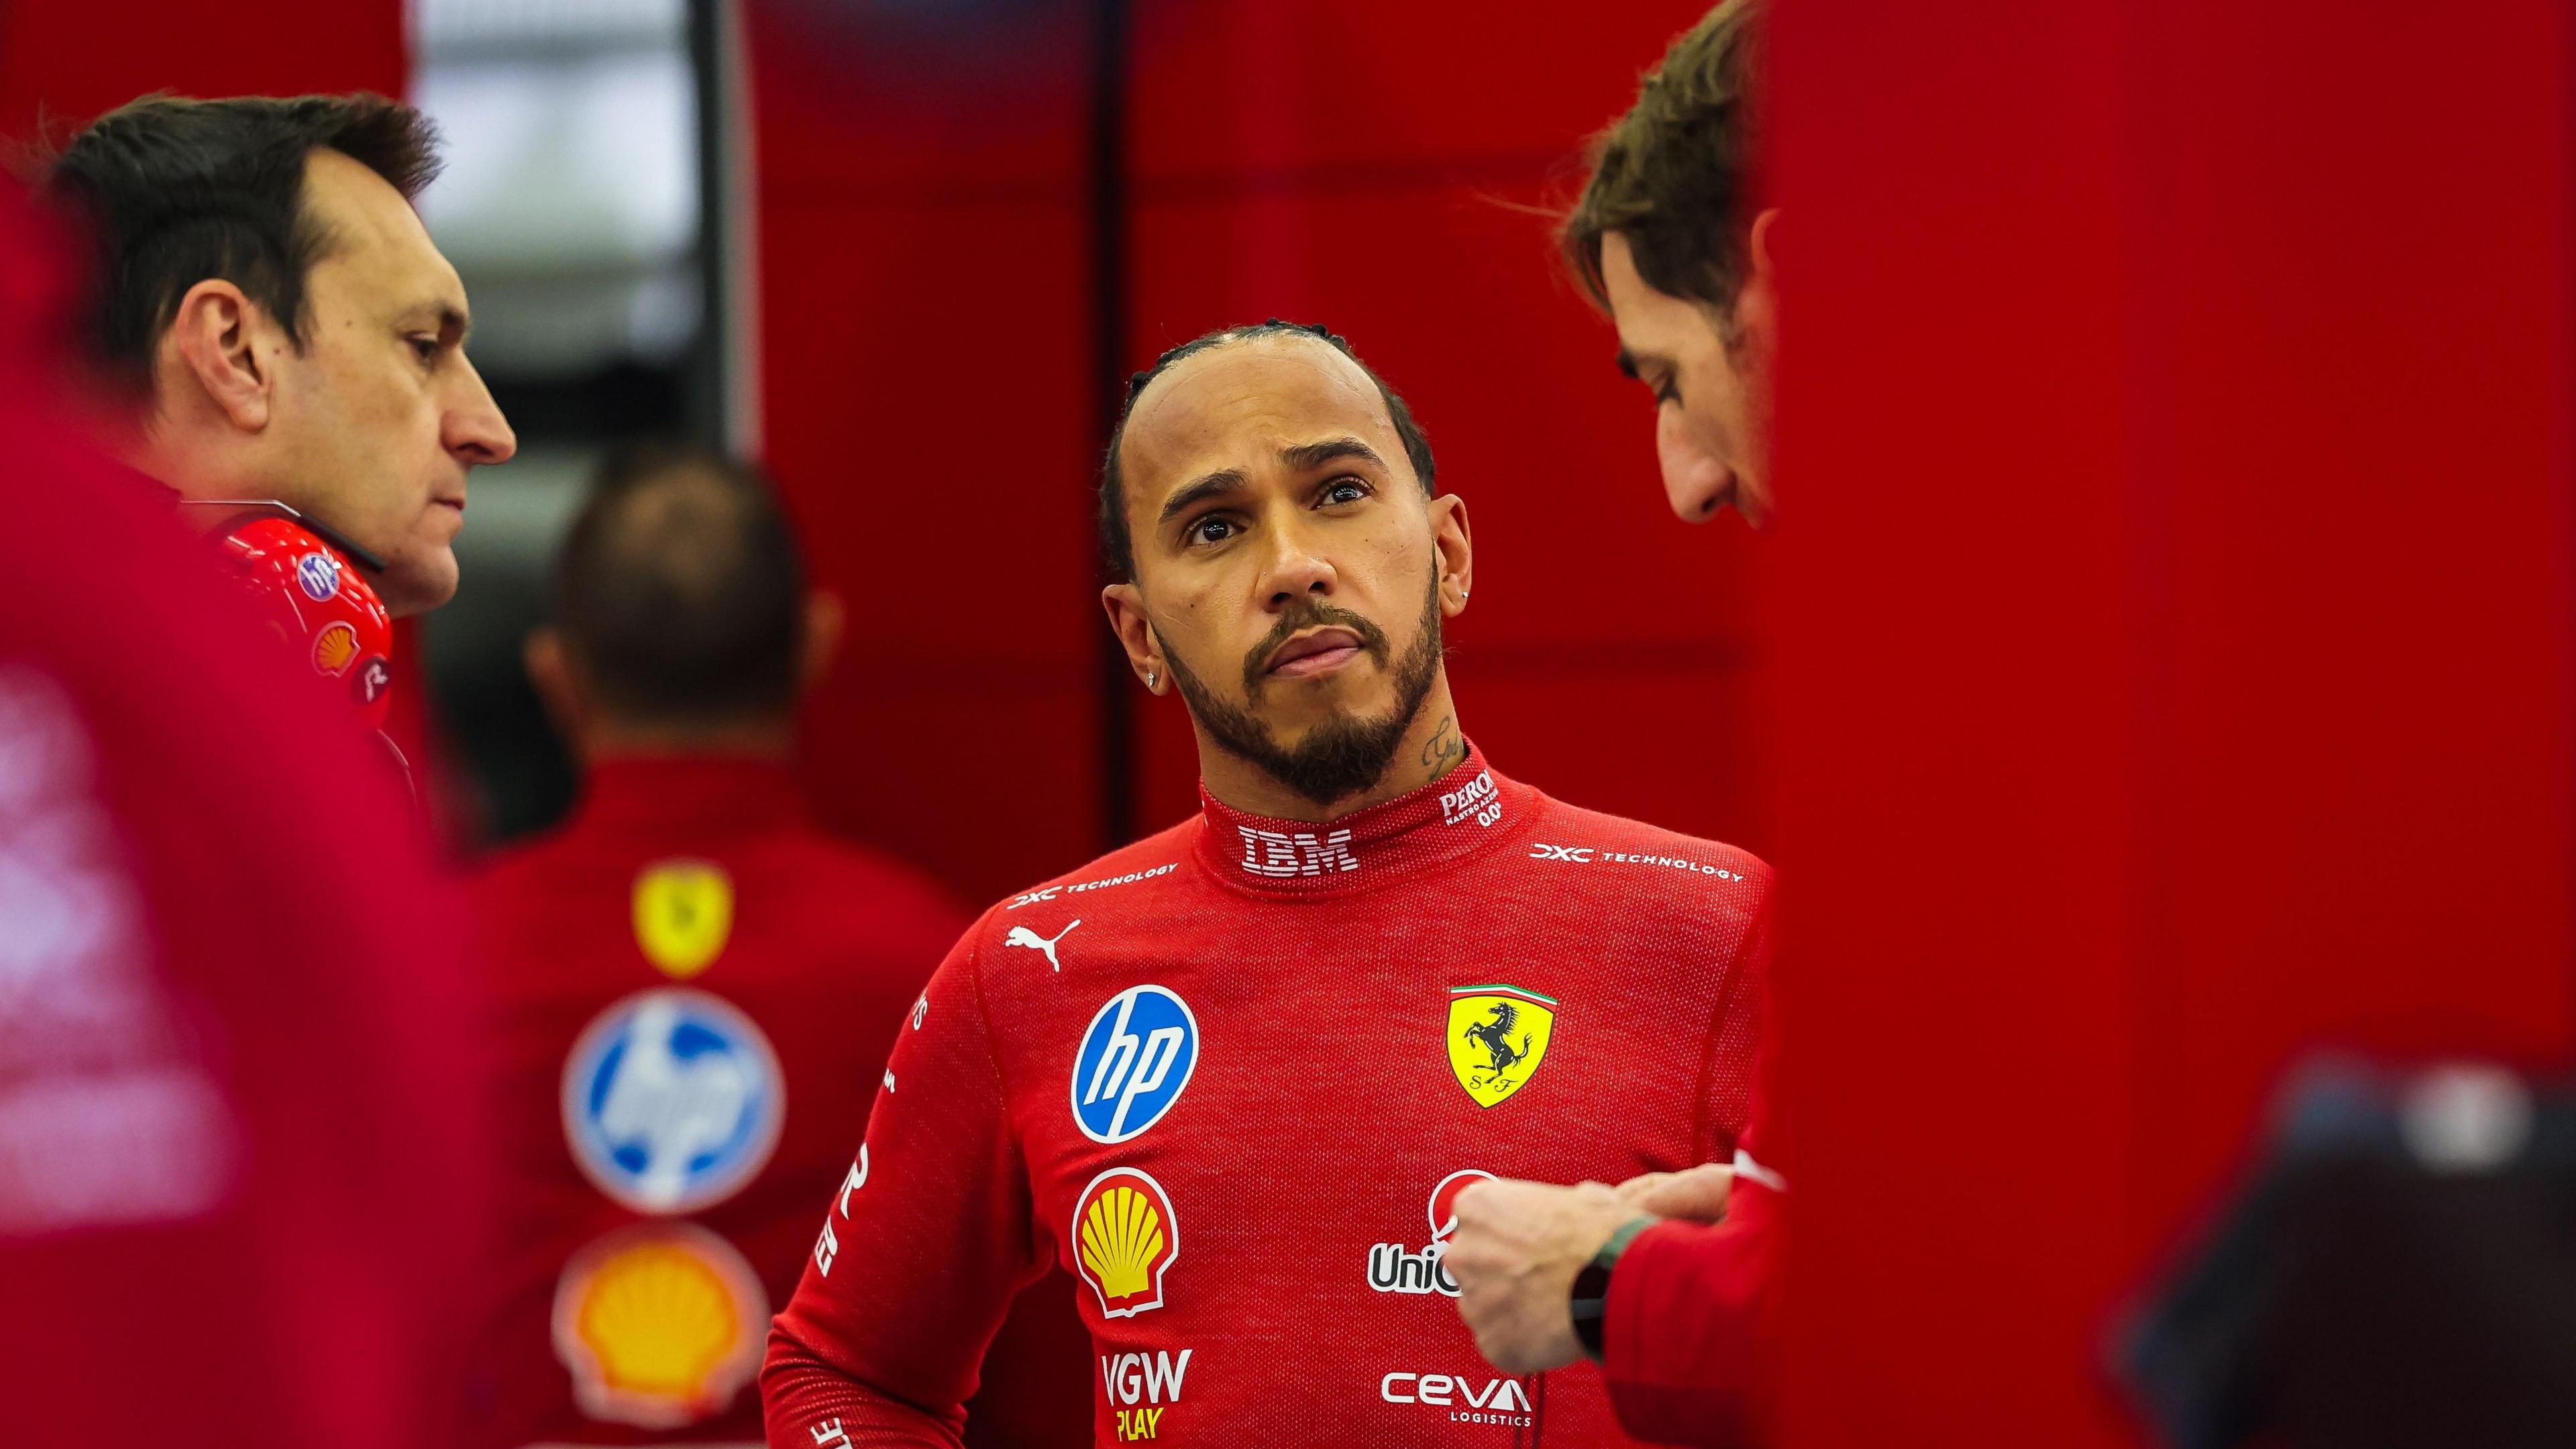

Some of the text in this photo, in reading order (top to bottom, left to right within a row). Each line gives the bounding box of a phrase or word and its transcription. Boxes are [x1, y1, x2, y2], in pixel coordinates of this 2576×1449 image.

[1446, 803, 1480, 826] NASTRO
[1238, 825, 1358, 877] IBM
[1529, 843, 1744, 883] DXC TECHNOLOGY
[1006, 862, 1179, 910] DXC TECHNOLOGY
[1083, 991, 1183, 1138] hp
[1469, 1075, 1482, 1090] S
[1101, 1348, 1193, 1407] VGW
[1116, 1407, 1165, 1442] PLAY
[1450, 1411, 1532, 1428] LOGISTICS
